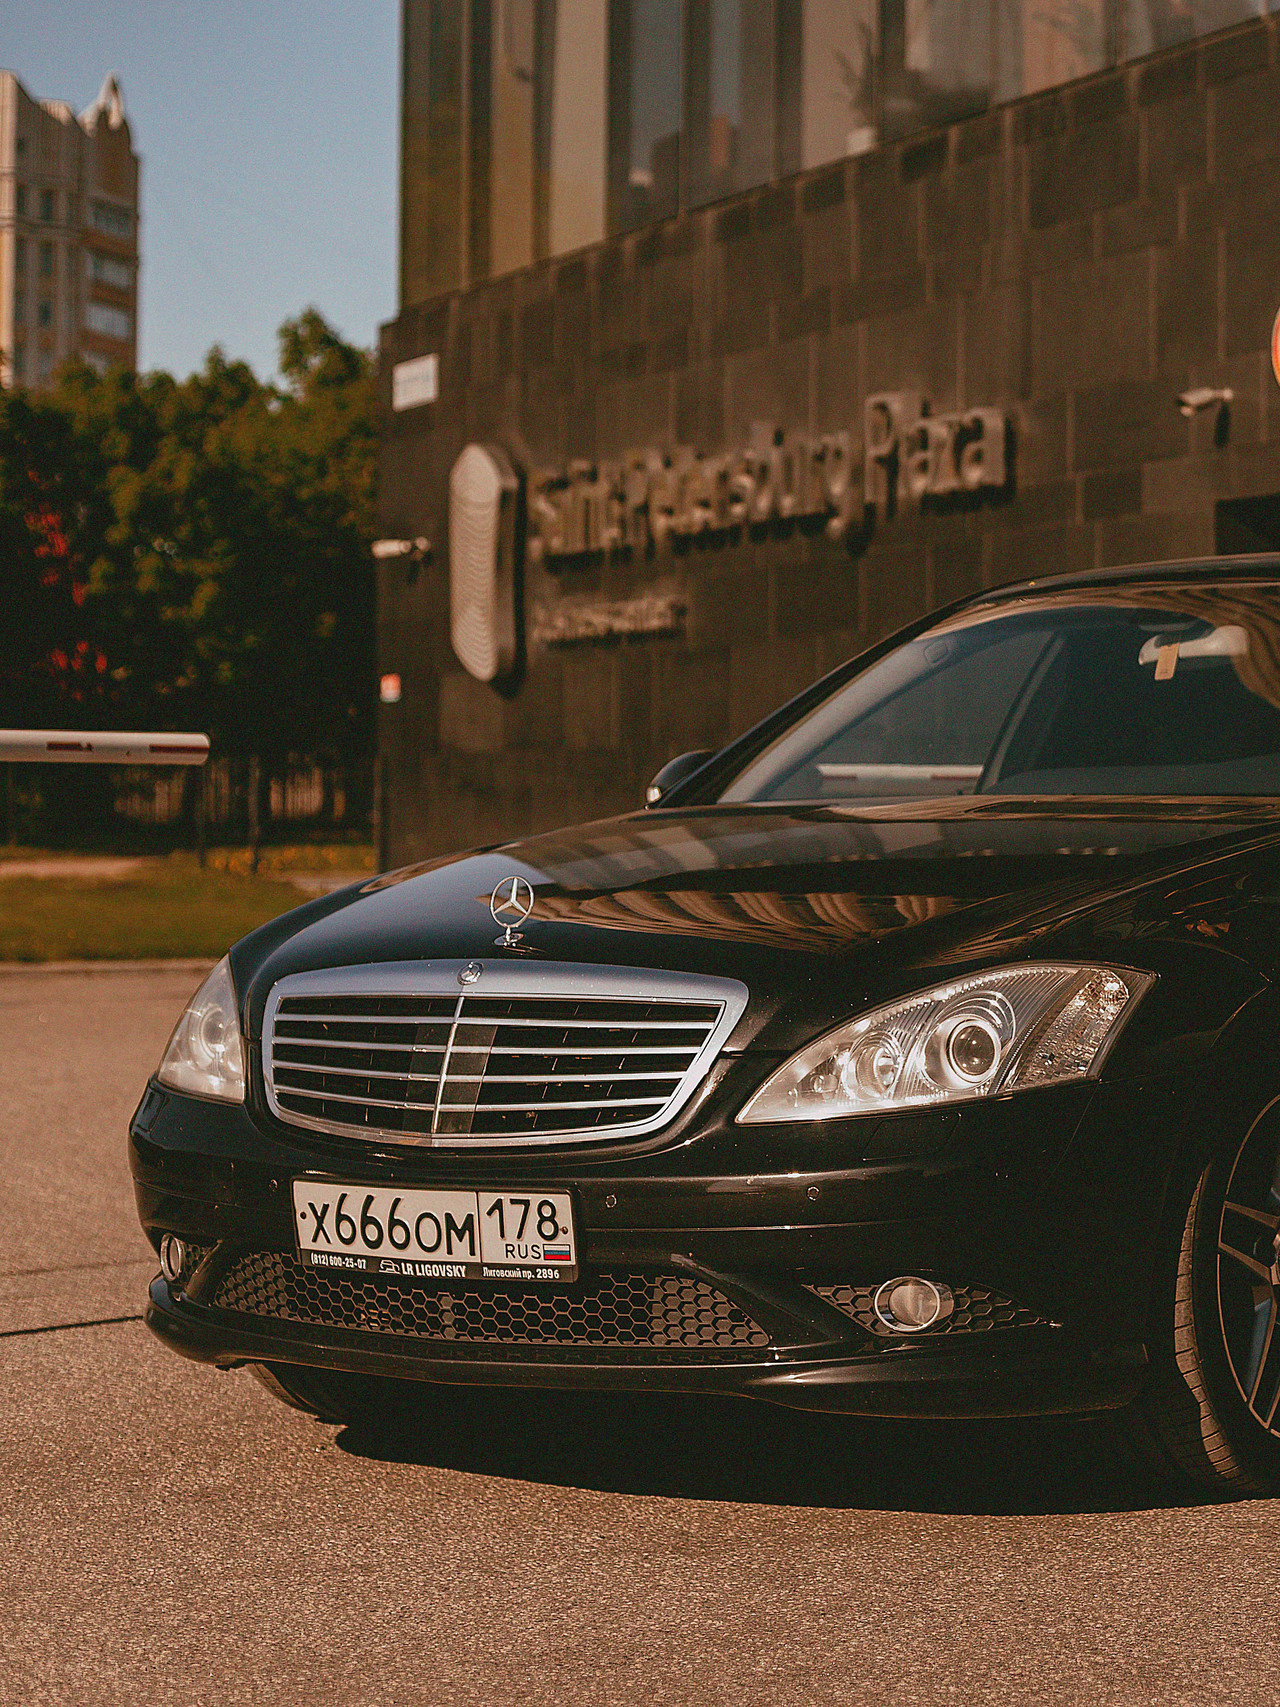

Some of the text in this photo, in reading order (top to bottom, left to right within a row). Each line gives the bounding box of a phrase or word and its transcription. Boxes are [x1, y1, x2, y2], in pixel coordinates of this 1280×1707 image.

[486, 1198, 560, 1241] 178
[505, 1243, 541, 1260] RUS
[311, 1252, 366, 1270] (812) 600-25-07
[401, 1262, 466, 1278] LR LIGOVSKY
